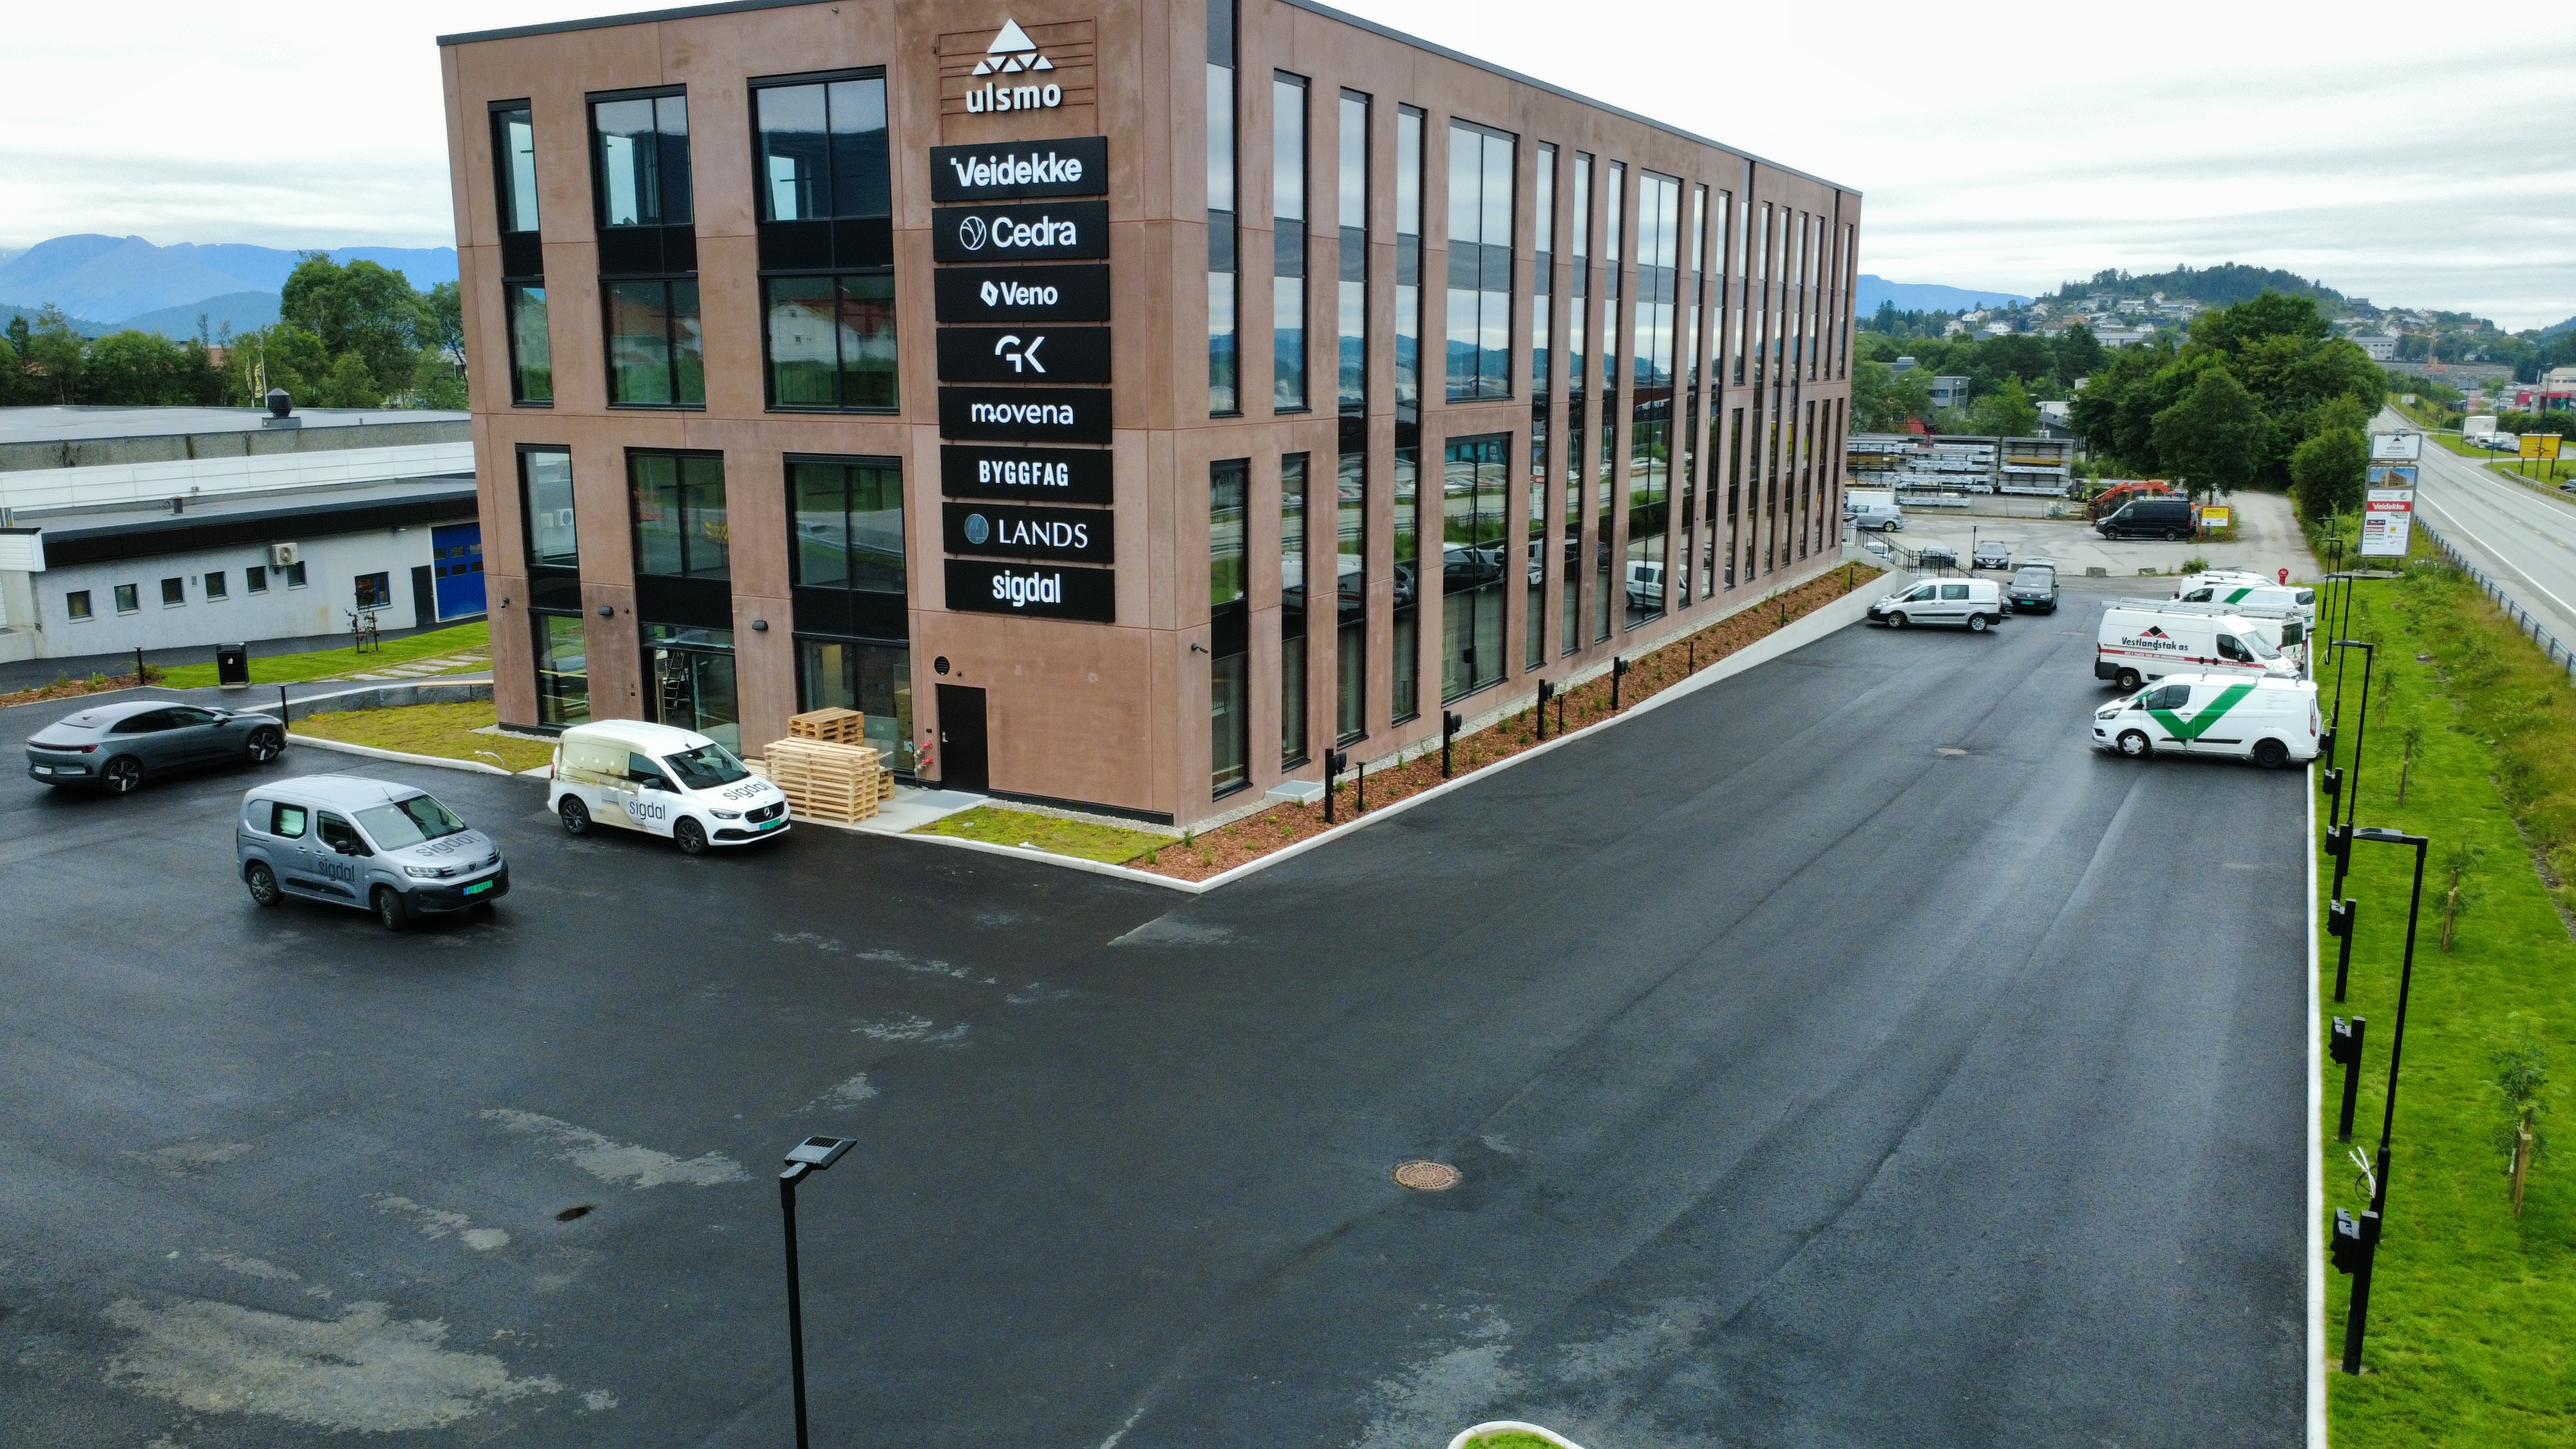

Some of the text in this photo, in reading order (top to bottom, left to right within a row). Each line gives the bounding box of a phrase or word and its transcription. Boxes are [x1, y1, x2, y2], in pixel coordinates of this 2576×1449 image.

[965, 82, 1062, 113] ulsmo
[952, 152, 1083, 187] Veidekke
[992, 216, 1077, 248] Cedra
[1000, 281, 1058, 306] Veno
[994, 335, 1046, 374] GK
[971, 402, 1074, 425] movena
[979, 460, 1068, 487] BYGGFAG
[998, 519, 1088, 549] LANDS
[992, 570, 1061, 607] sigdal
[2121, 636, 2177, 650] Vestlandstak
[722, 781, 773, 801] sigdal
[629, 799, 666, 820] sigdal
[415, 833, 481, 858] sigdal
[318, 858, 355, 882] sigdal
